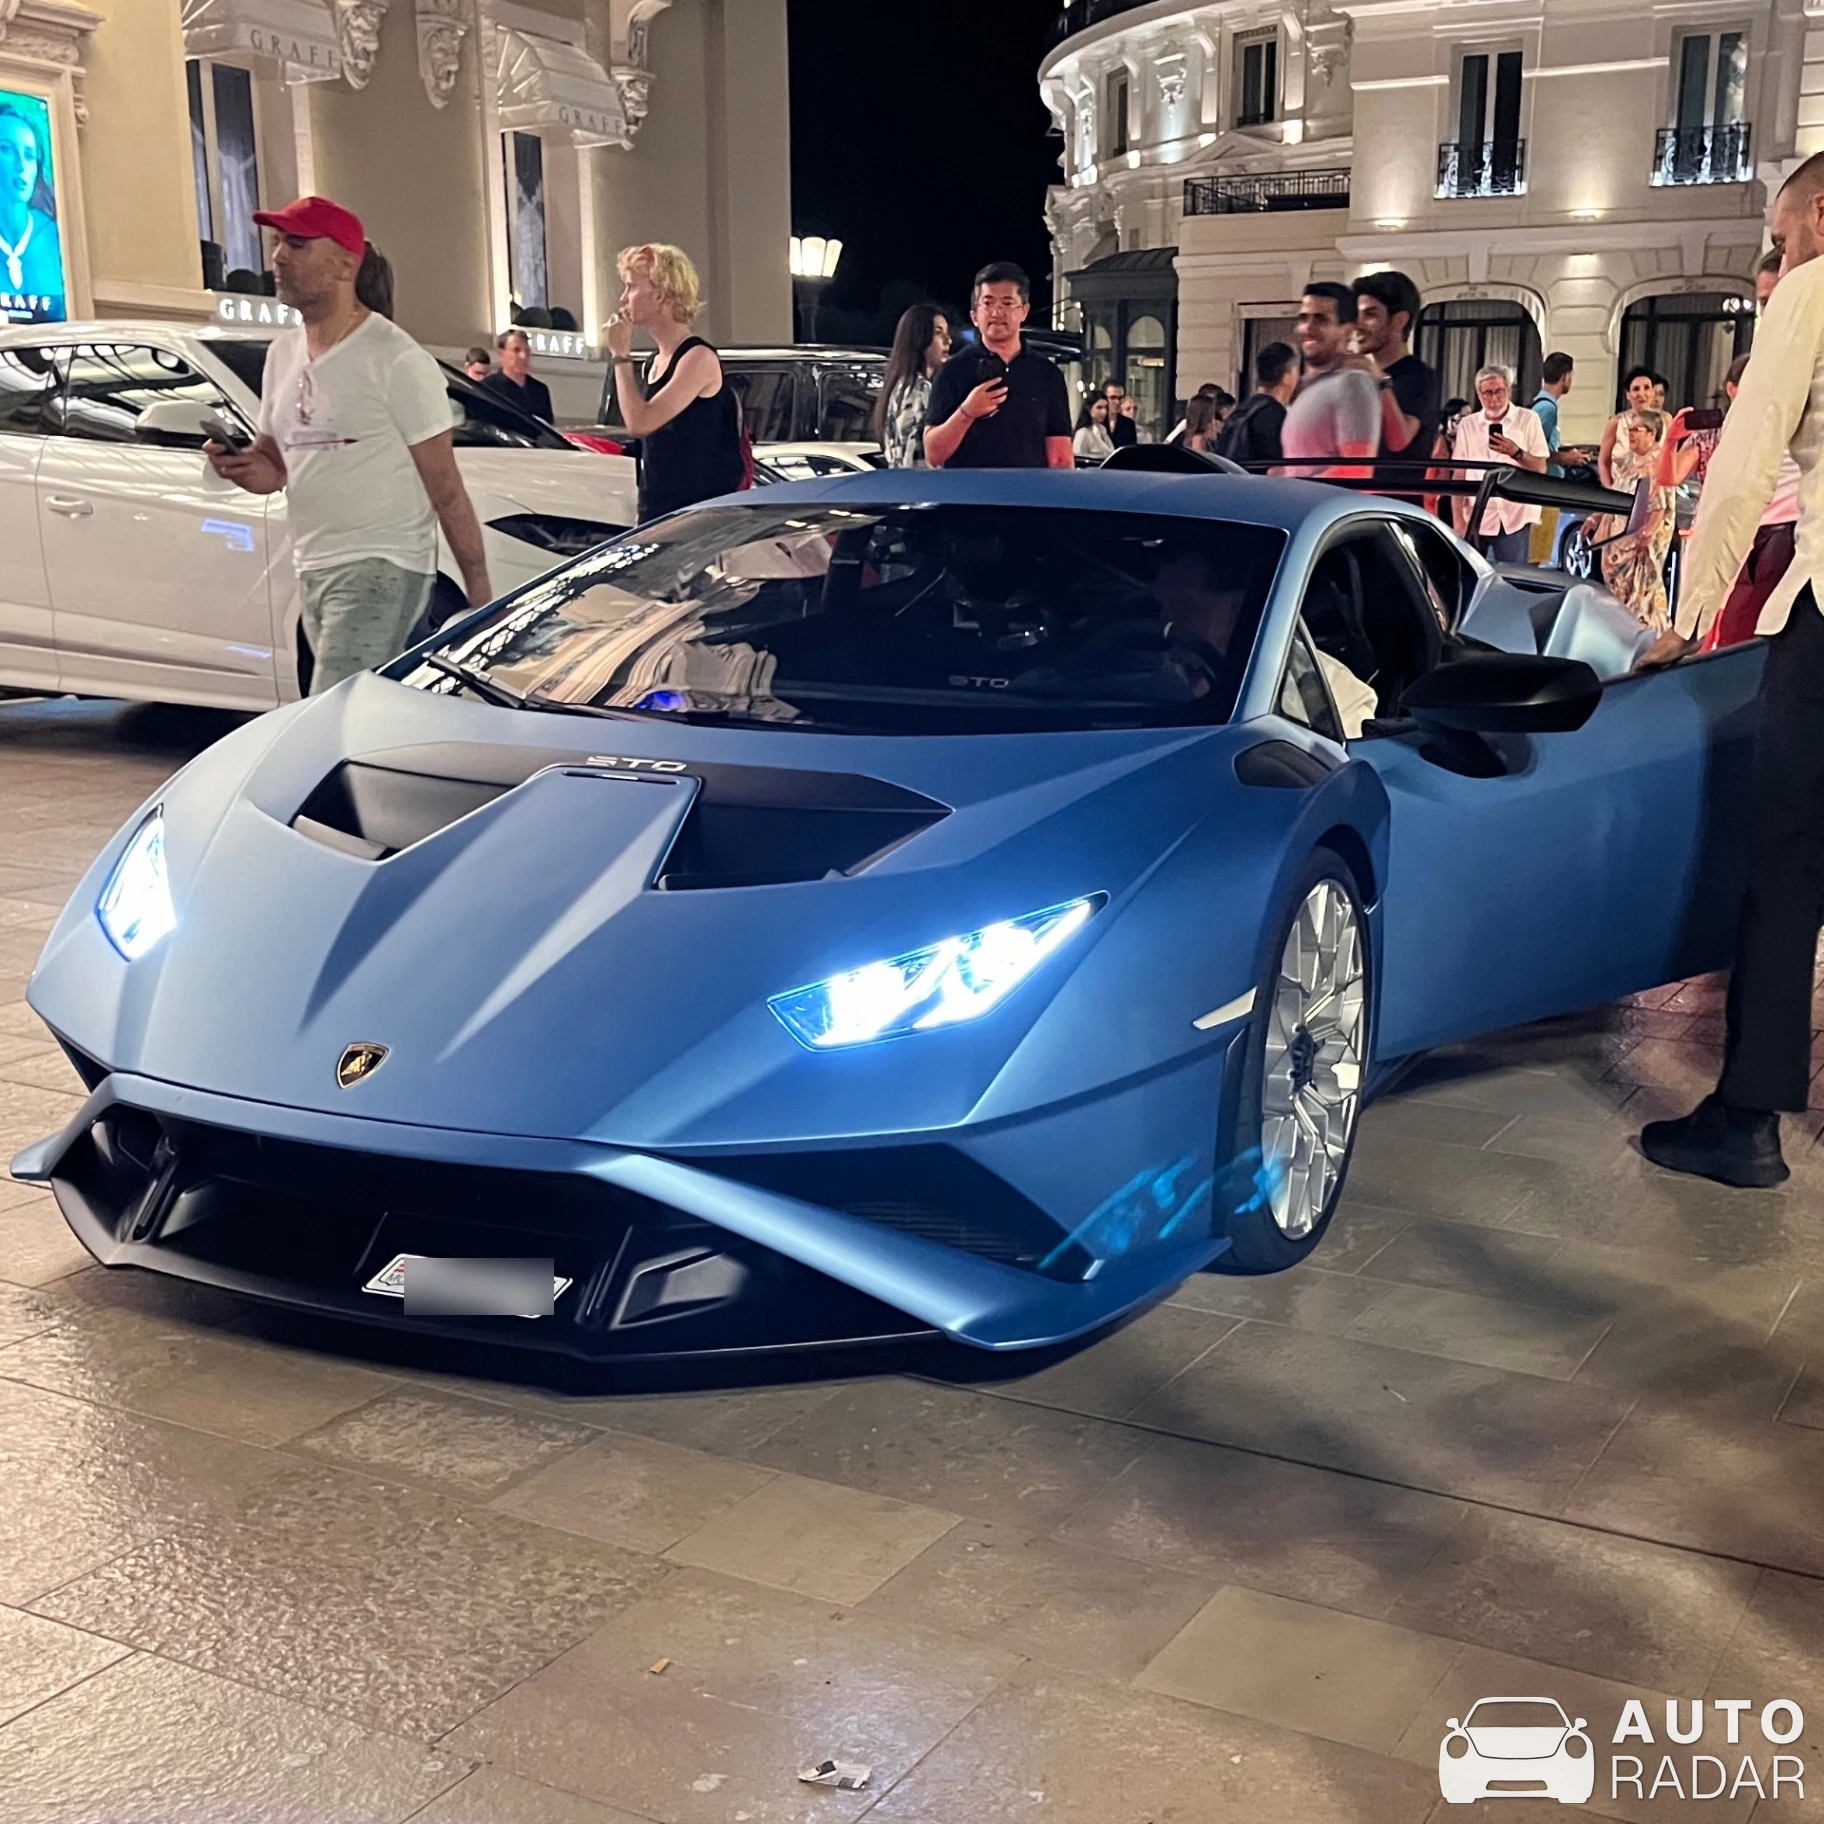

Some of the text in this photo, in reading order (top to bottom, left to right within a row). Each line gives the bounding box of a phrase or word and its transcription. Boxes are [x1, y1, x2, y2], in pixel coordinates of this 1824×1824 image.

[251, 29, 335, 69] GRAFF
[559, 106, 622, 136] GRAFF
[0, 291, 51, 311] RAFF
[586, 755, 687, 772] STO
